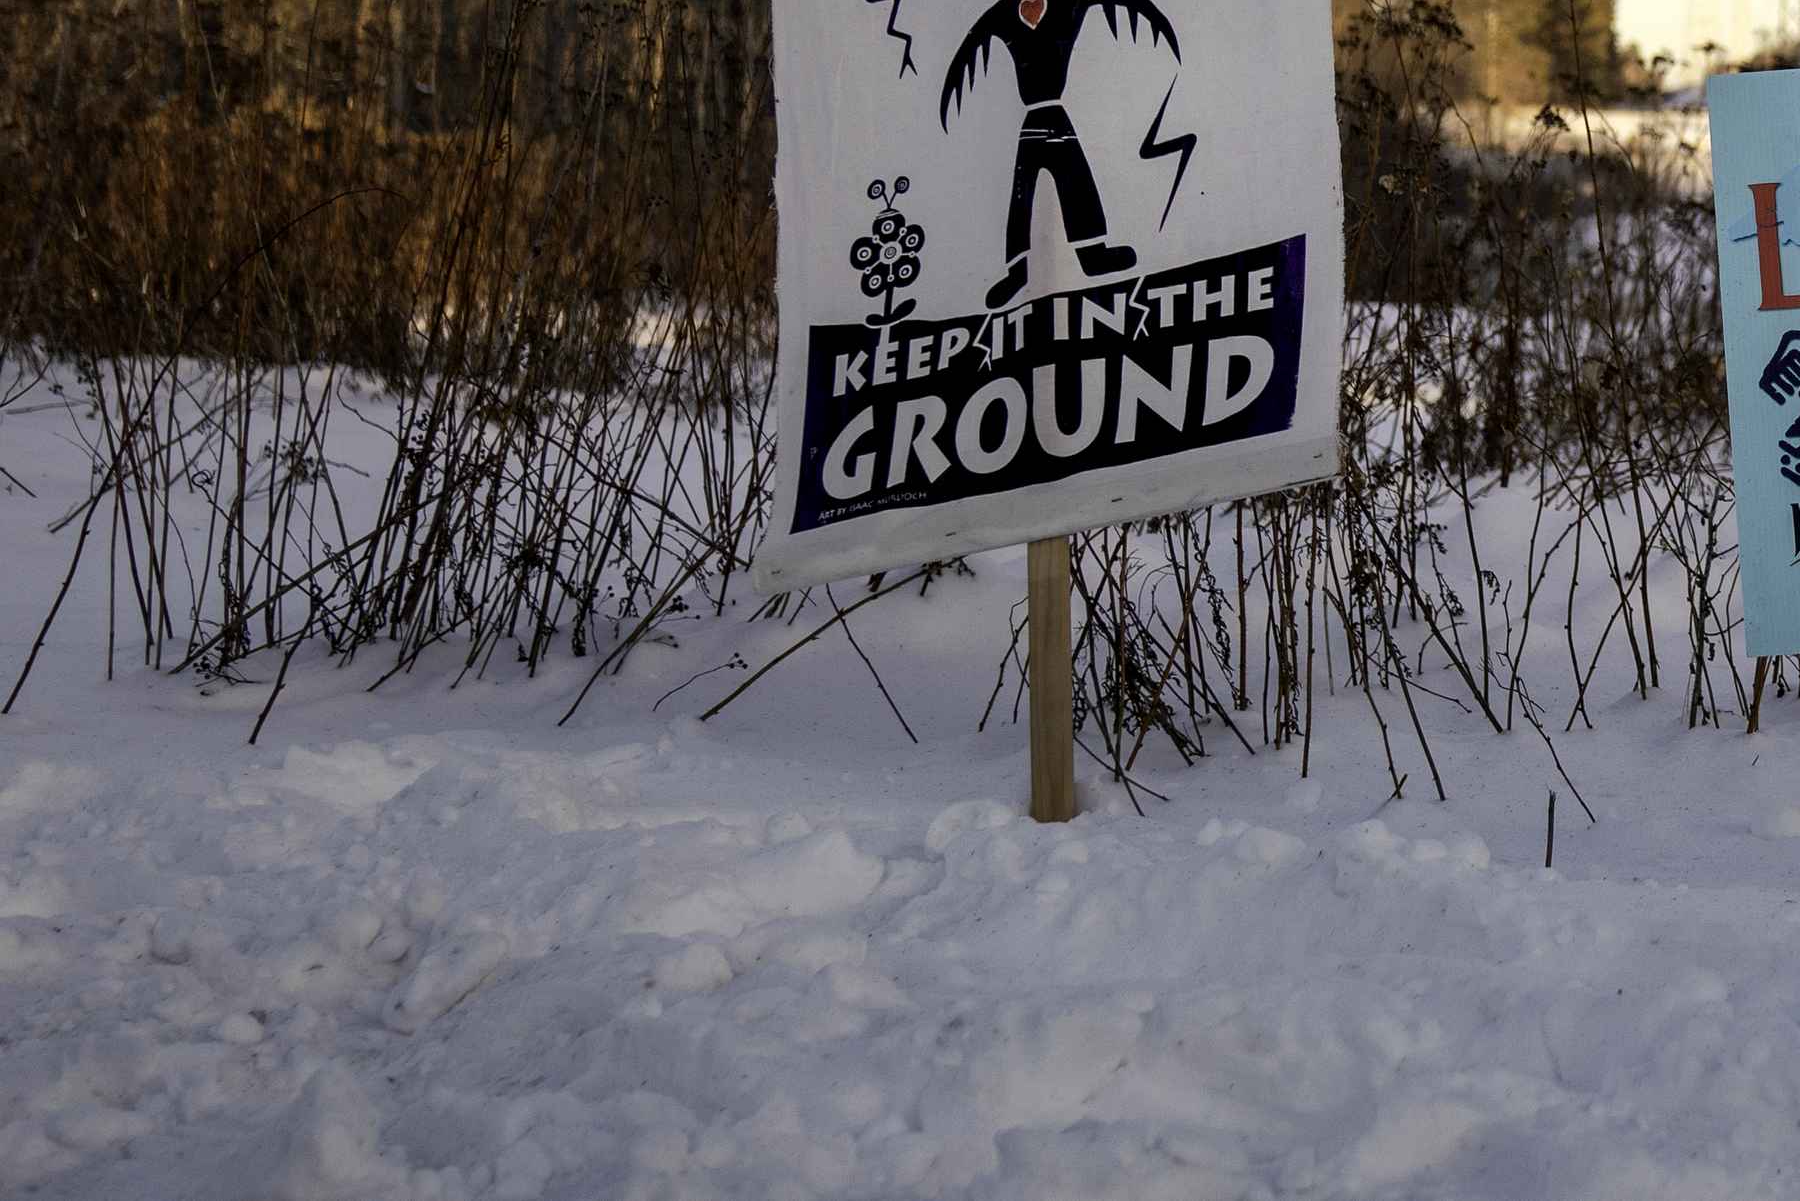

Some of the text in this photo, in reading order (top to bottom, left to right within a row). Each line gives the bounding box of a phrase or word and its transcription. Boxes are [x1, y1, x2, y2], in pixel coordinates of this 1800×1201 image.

[832, 265, 1276, 397] KEEP IT IN THE
[821, 334, 1276, 501] GROUND
[818, 509, 835, 520] ART
